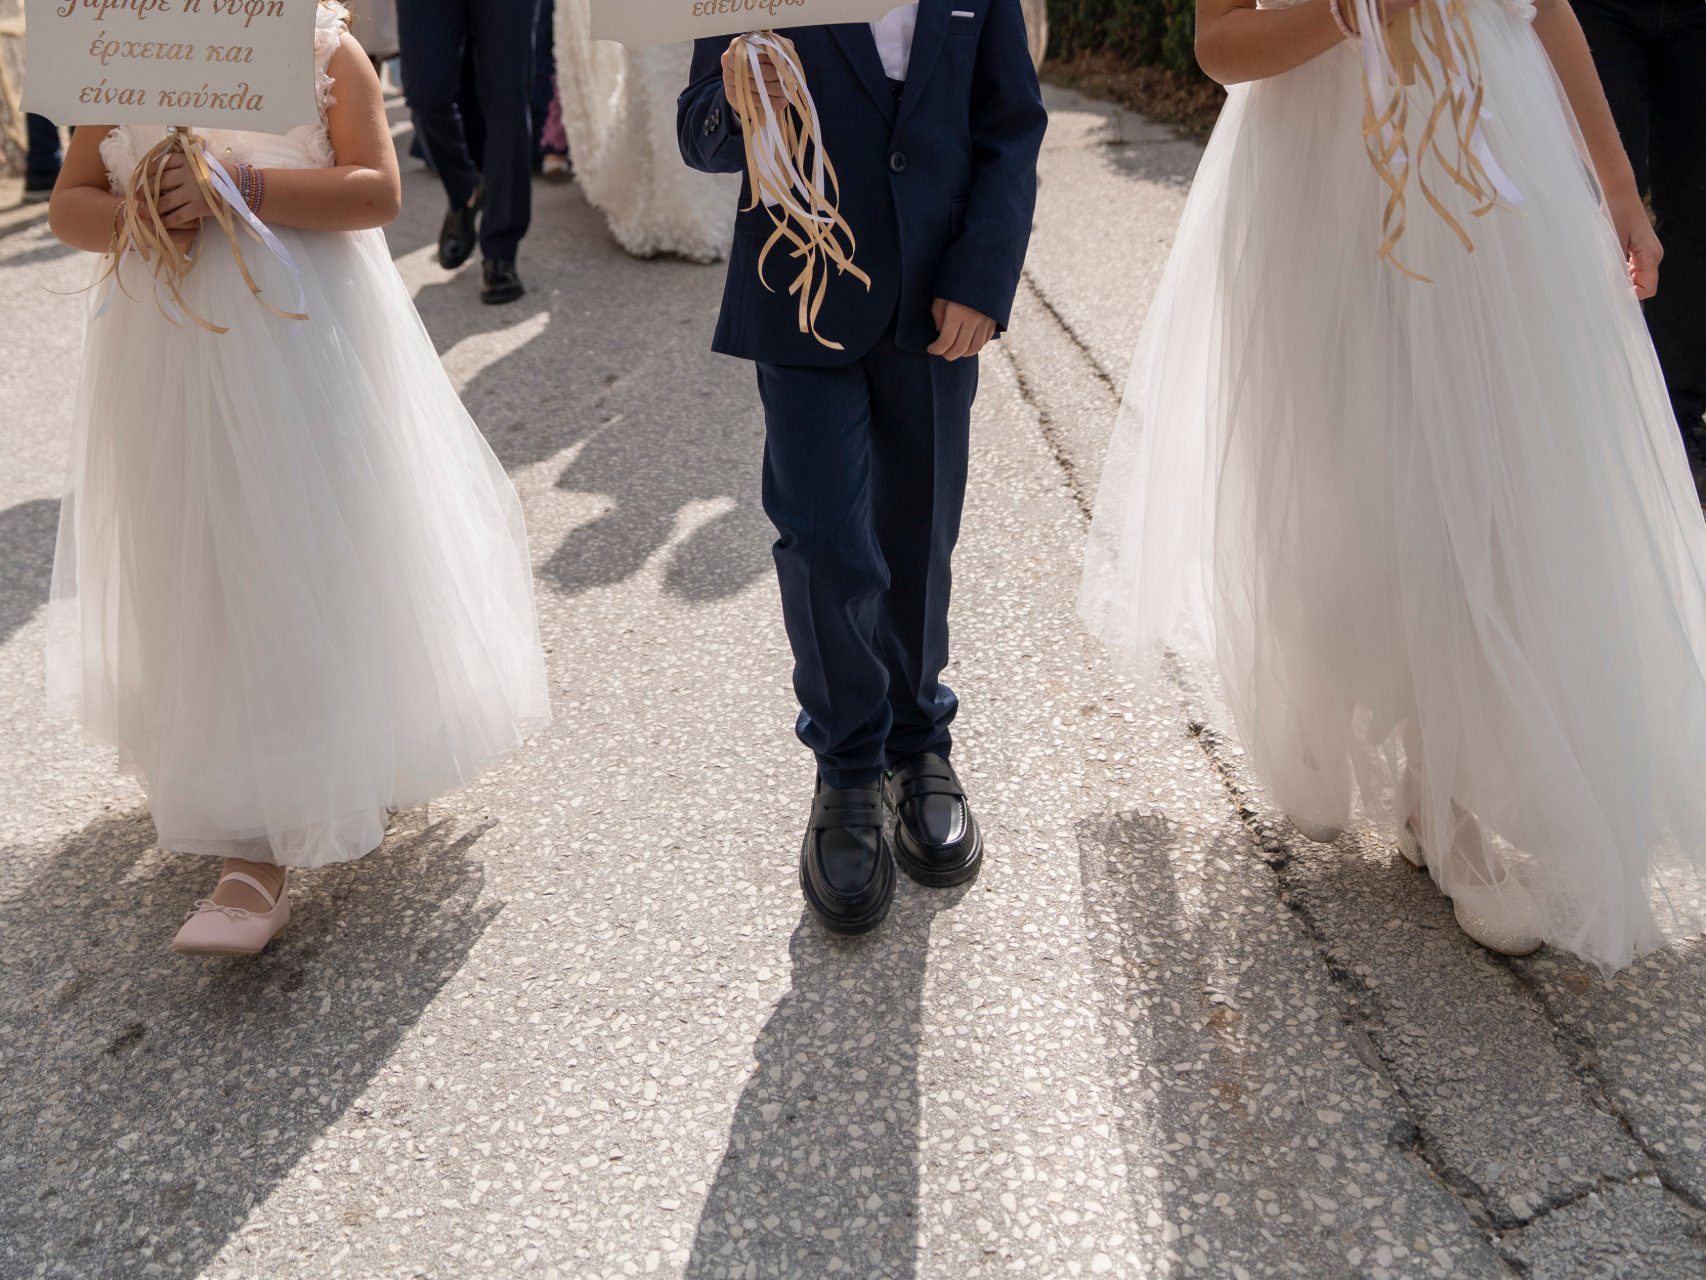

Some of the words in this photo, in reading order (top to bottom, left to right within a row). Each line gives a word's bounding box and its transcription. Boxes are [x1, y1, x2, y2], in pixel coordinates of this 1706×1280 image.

[90, 31, 194, 66] έρχεται
[207, 43, 252, 63] και
[79, 79, 145, 105] είναι
[158, 83, 263, 111] κούκλα
